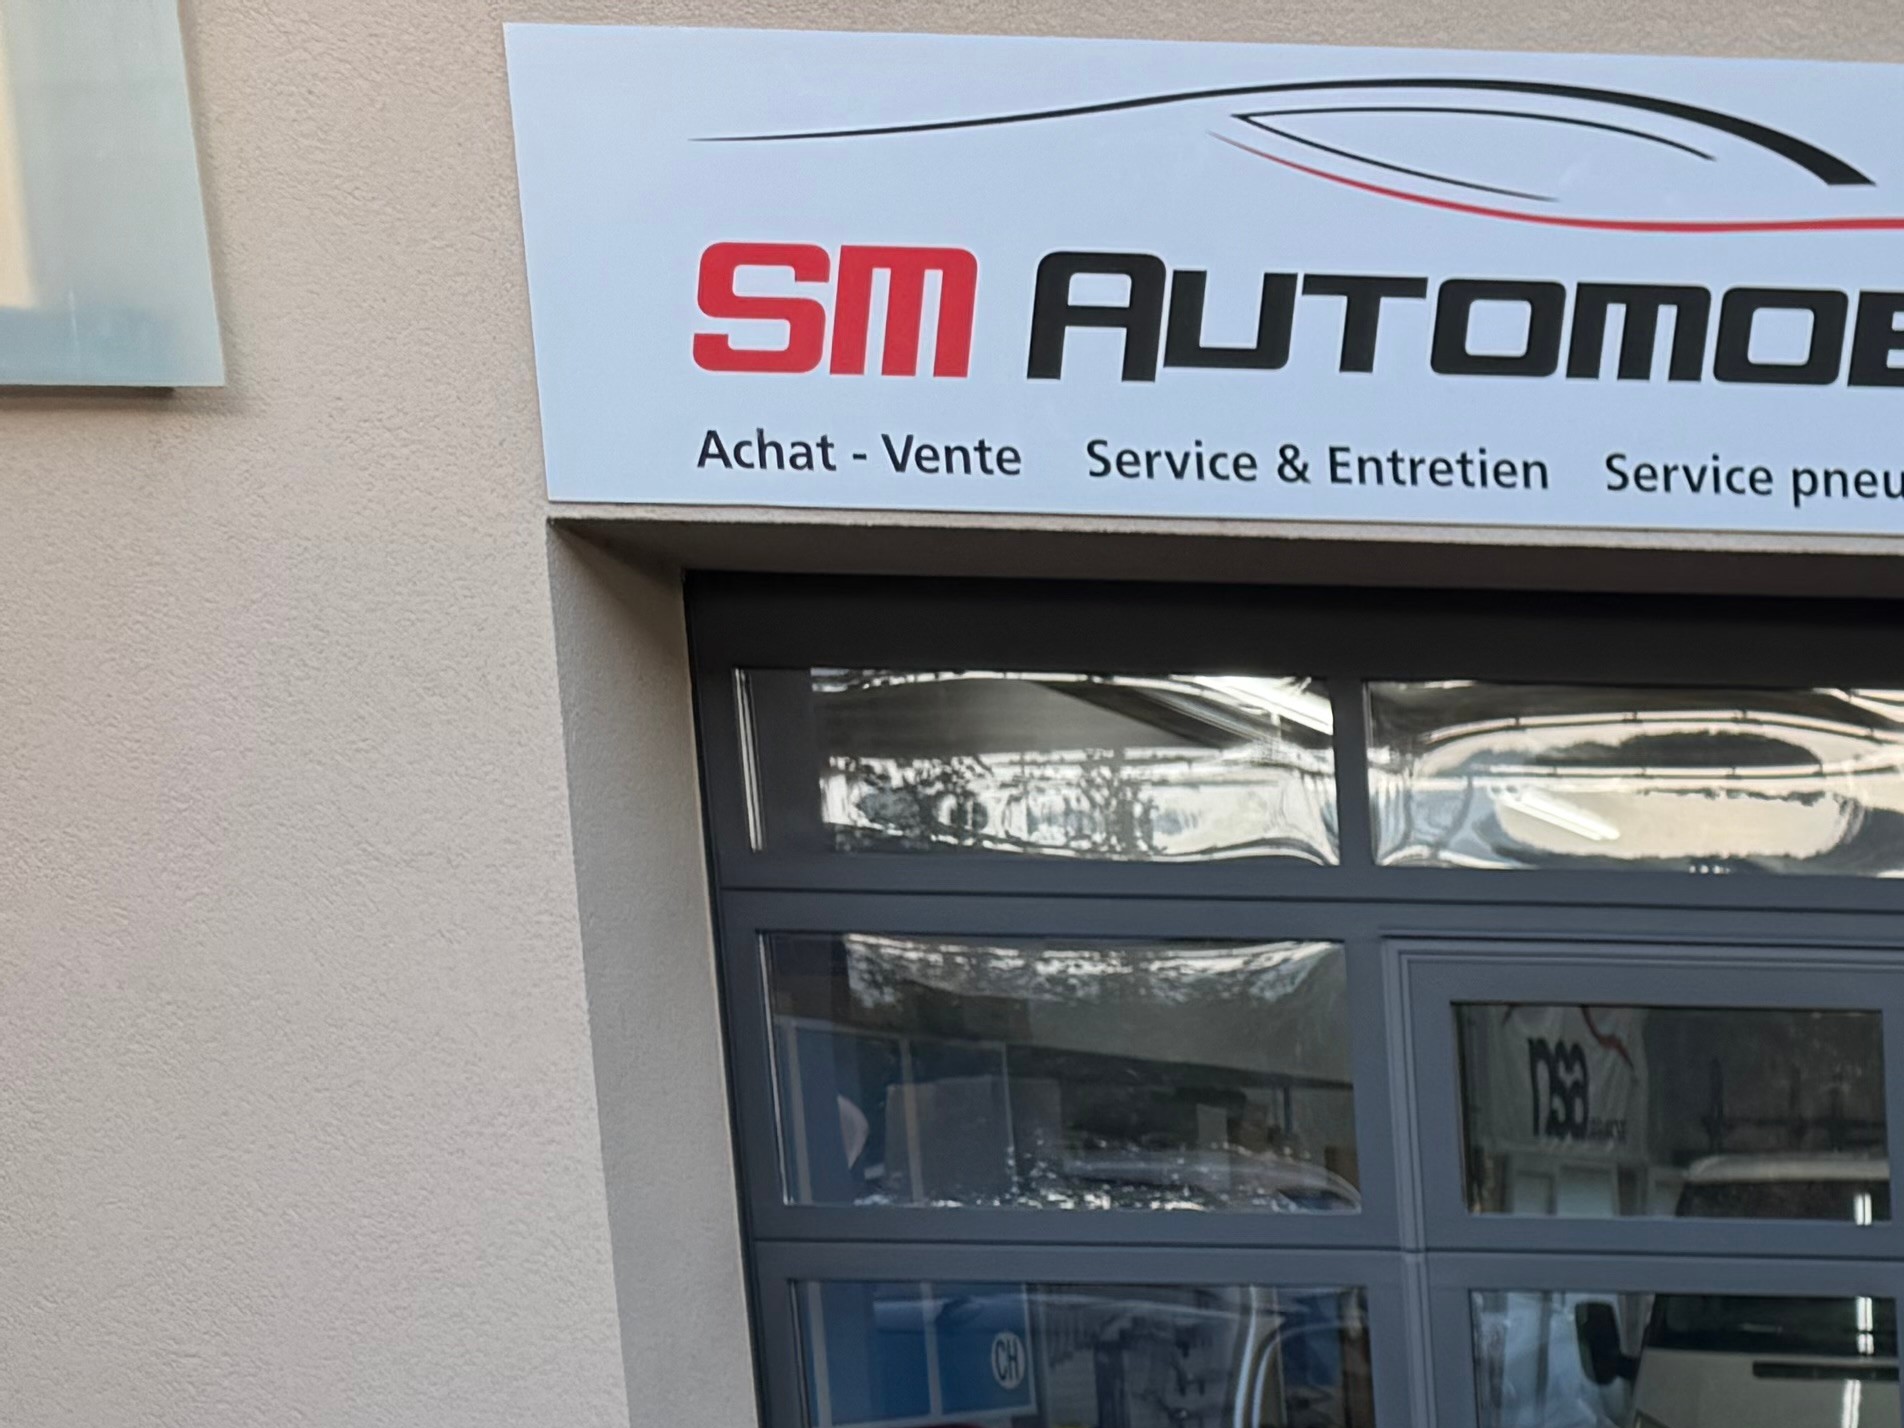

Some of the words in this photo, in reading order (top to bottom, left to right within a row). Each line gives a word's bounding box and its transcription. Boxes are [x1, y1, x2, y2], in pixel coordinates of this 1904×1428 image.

[693, 242, 978, 379] SM
[697, 428, 837, 472] Achat
[881, 434, 1022, 476] Vente
[1086, 438, 1258, 482] Service
[1276, 443, 1312, 484] &
[1328, 446, 1549, 490] Entretien
[1605, 453, 1774, 497] Service
